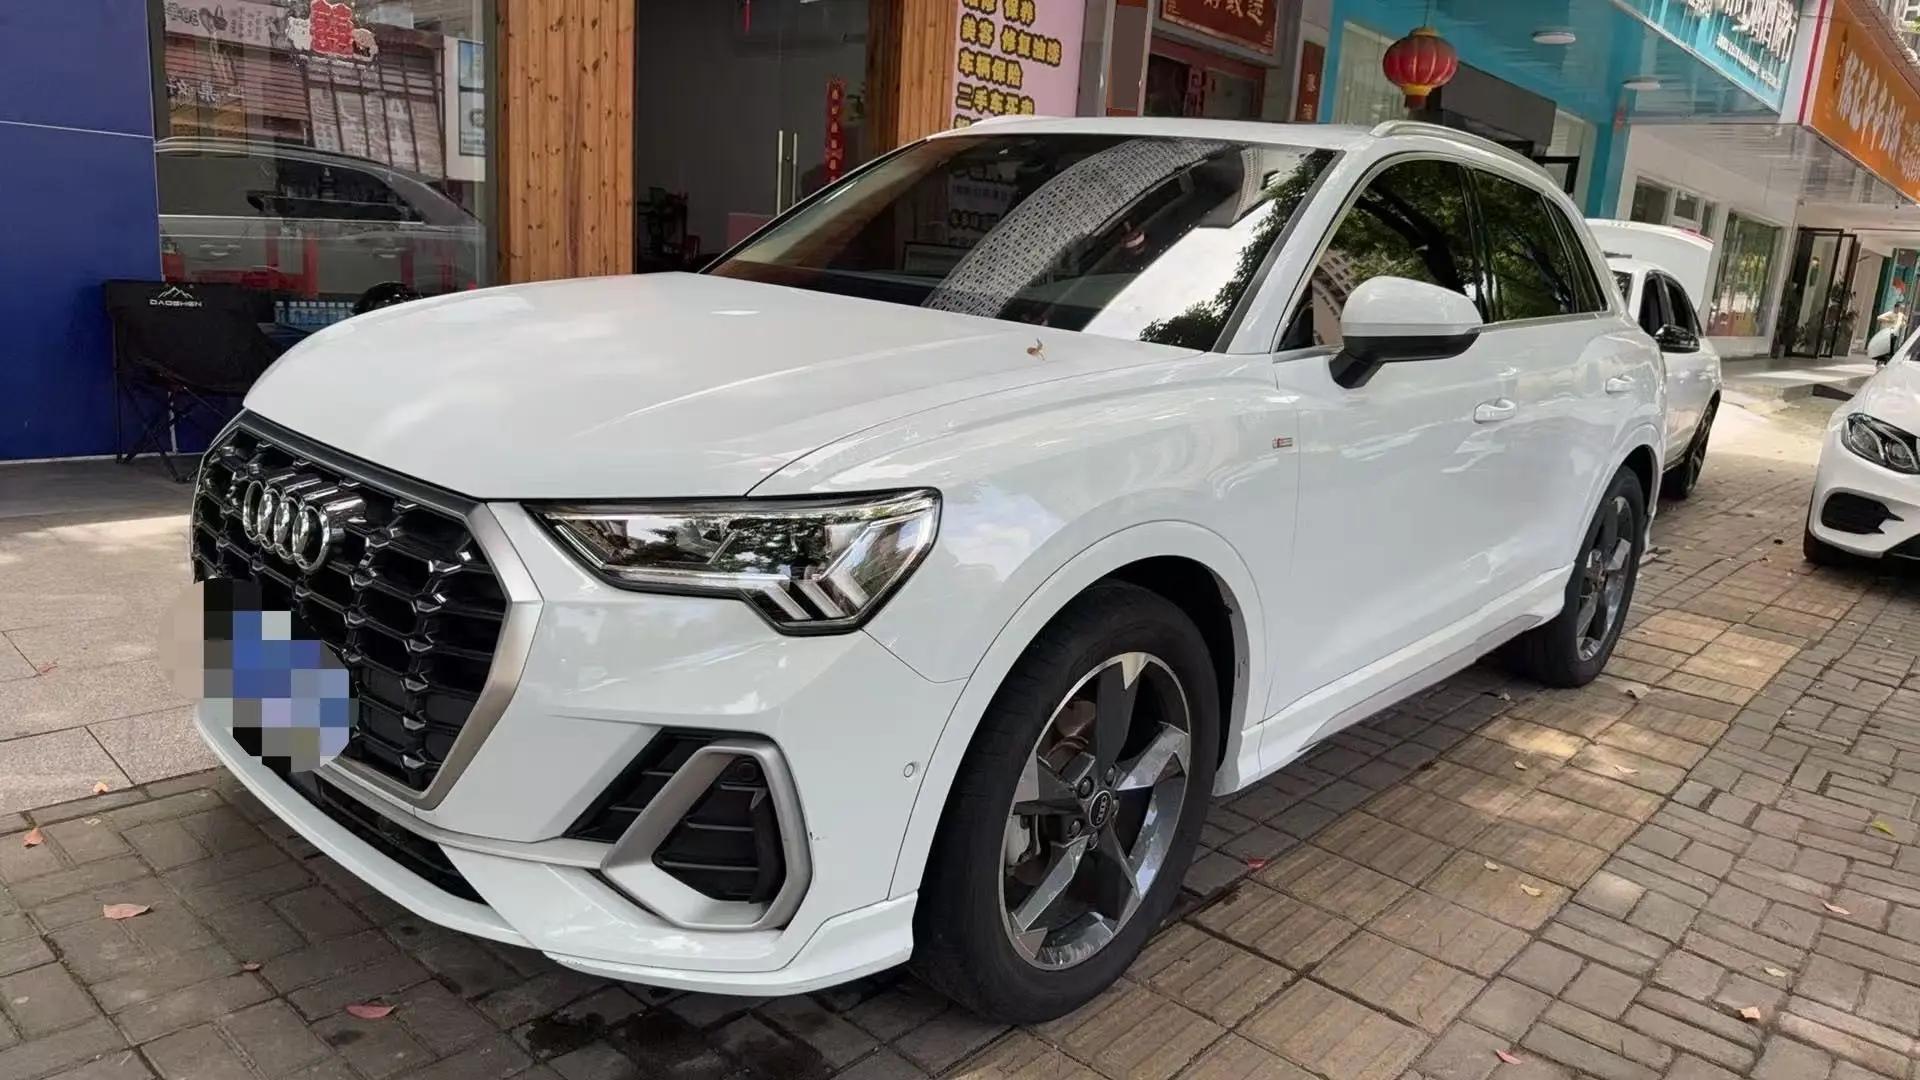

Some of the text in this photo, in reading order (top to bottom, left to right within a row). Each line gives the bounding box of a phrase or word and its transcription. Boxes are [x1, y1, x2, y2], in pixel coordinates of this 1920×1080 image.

[961, 14, 994, 47] 美容
[959, 47, 1022, 89] 车辆保险
[149, 299, 202, 307] DAOSHEN
